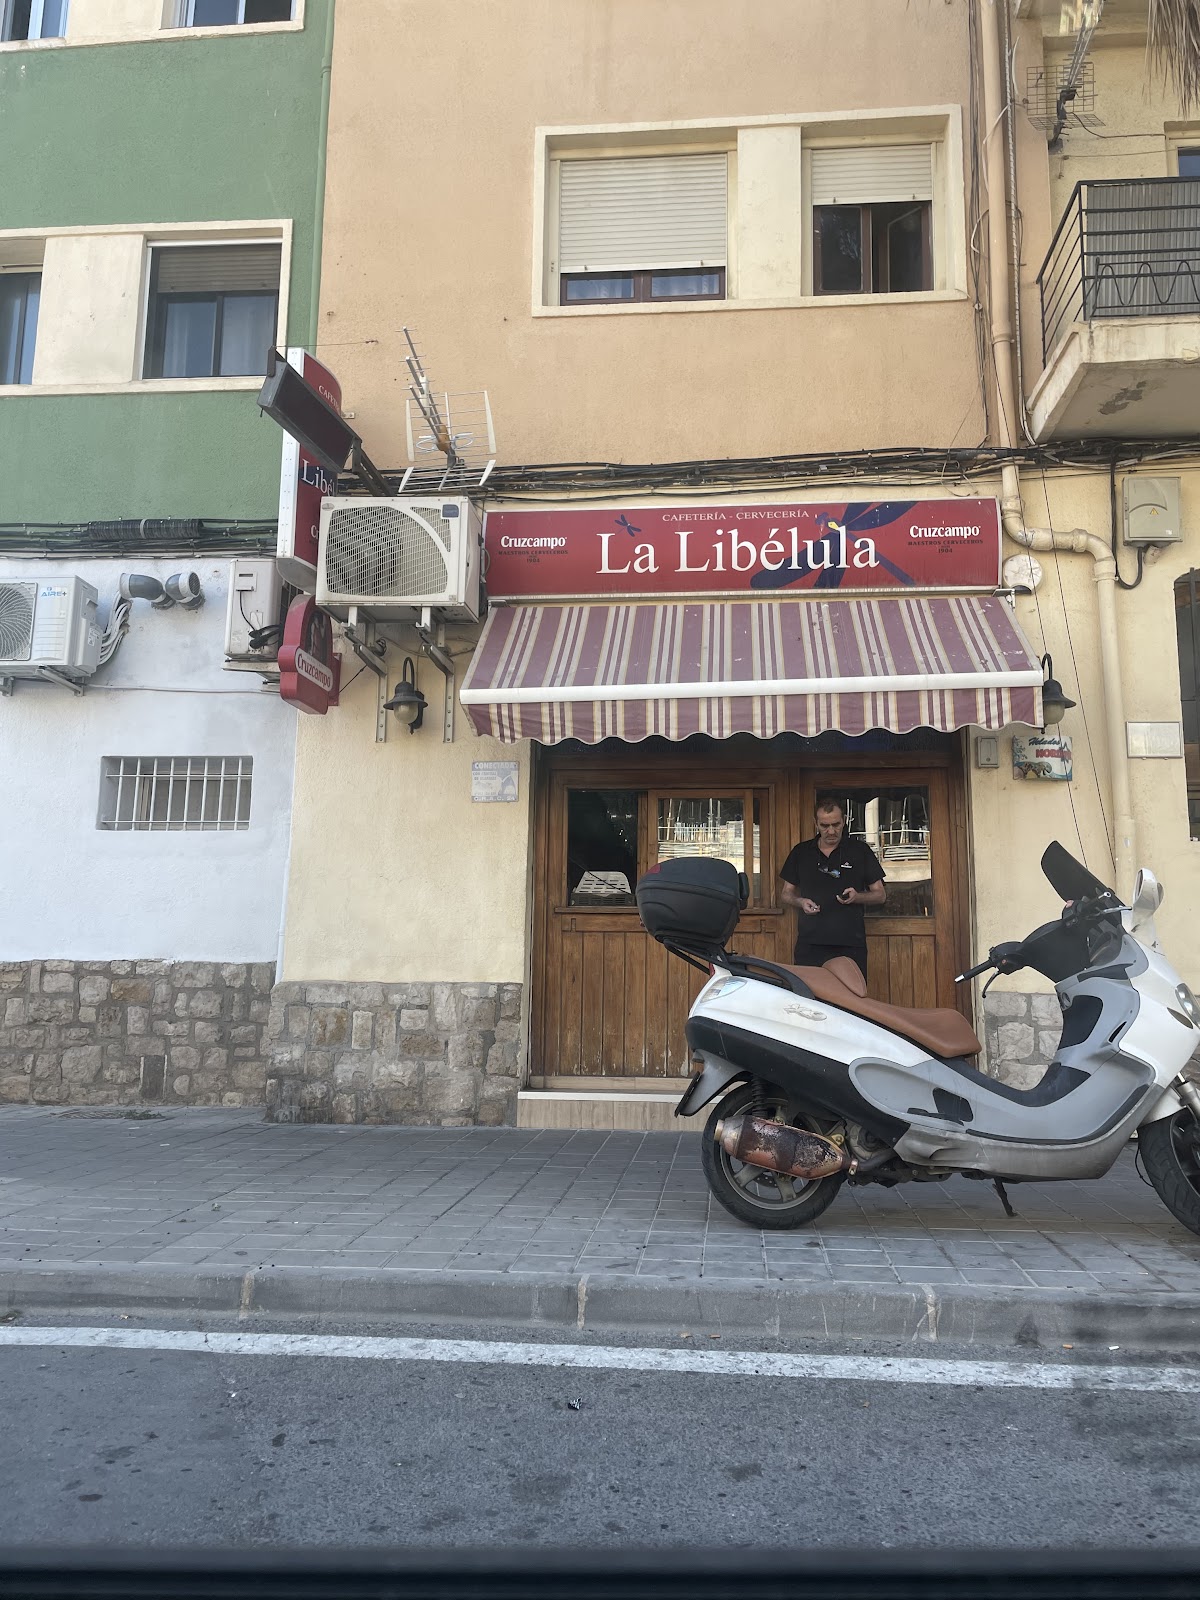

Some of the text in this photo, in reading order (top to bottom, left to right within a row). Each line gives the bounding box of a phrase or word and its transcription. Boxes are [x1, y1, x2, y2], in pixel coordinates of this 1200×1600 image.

[662, 511, 727, 522] CAFETERÍA
[735, 509, 809, 521] CERVECERÍA
[909, 525, 981, 539] Cruzcampo
[500, 535, 567, 549] Cruzcampo
[596, 525, 880, 574] La Libélula
[297, 653, 331, 688] Cruzcampo
